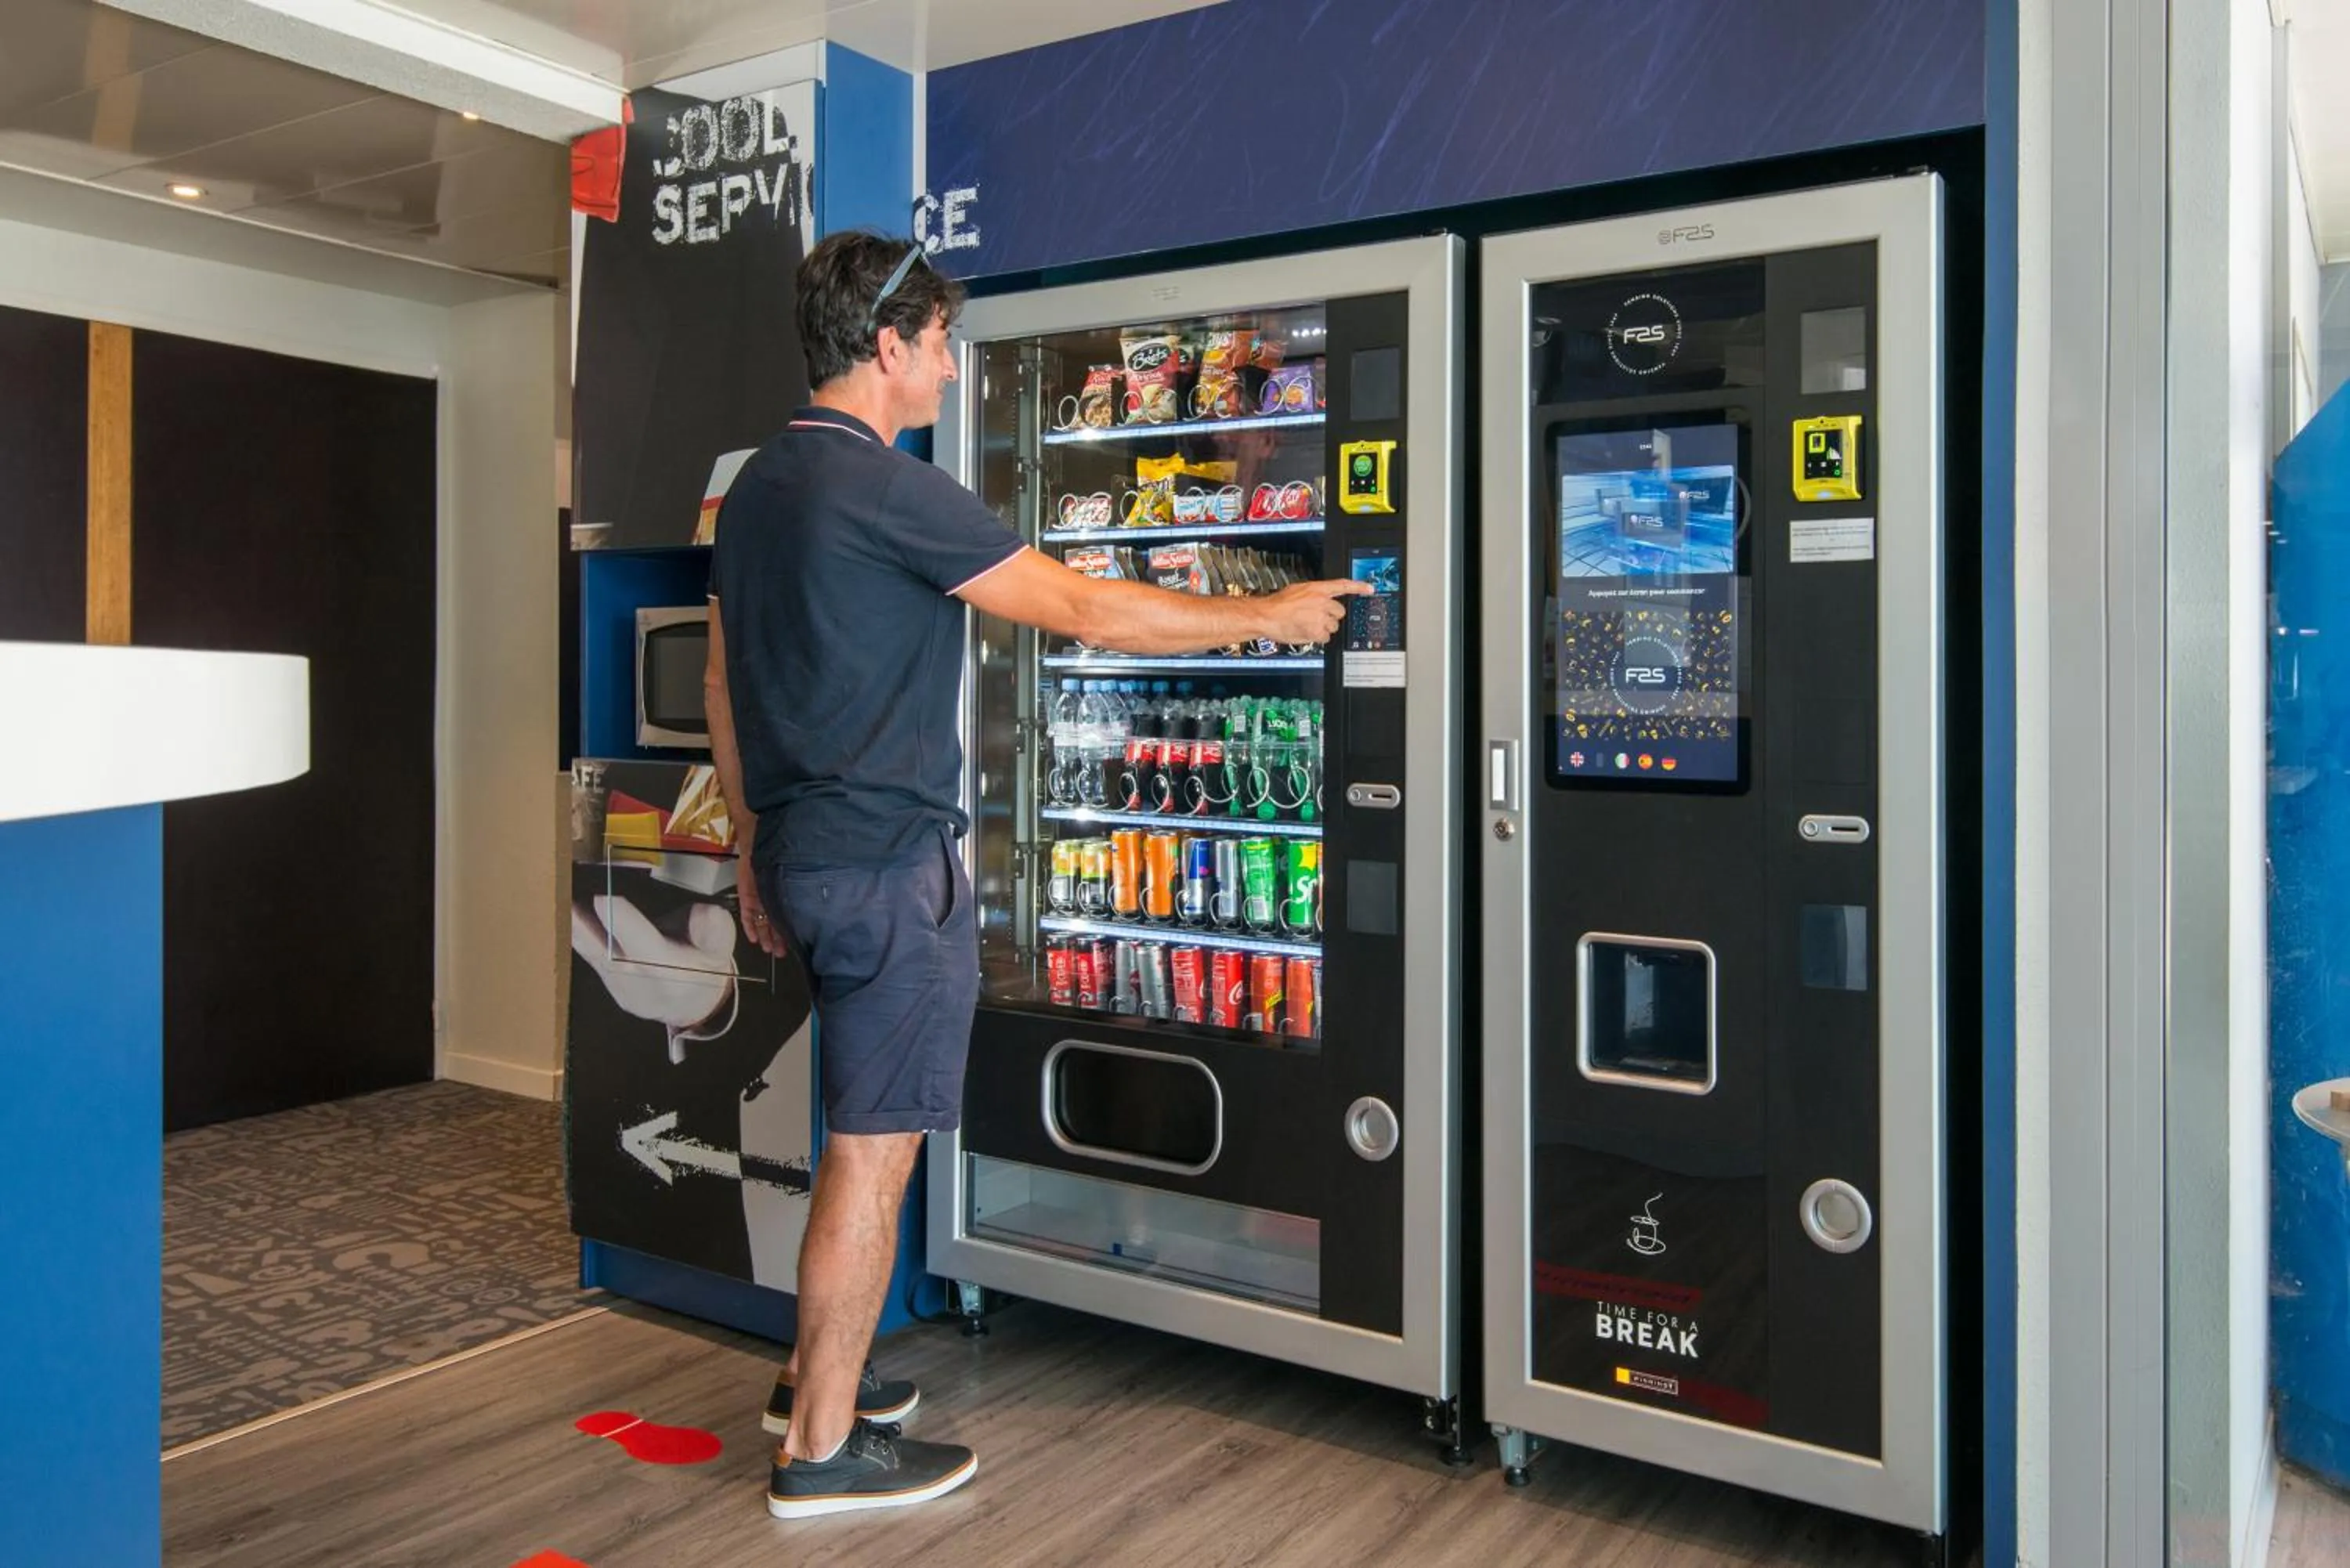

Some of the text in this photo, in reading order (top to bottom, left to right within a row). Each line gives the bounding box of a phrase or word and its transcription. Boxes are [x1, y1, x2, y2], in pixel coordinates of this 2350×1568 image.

[1596, 1301, 1699, 1333] TIME FOR A
[1596, 1313, 1699, 1358] BREAK
